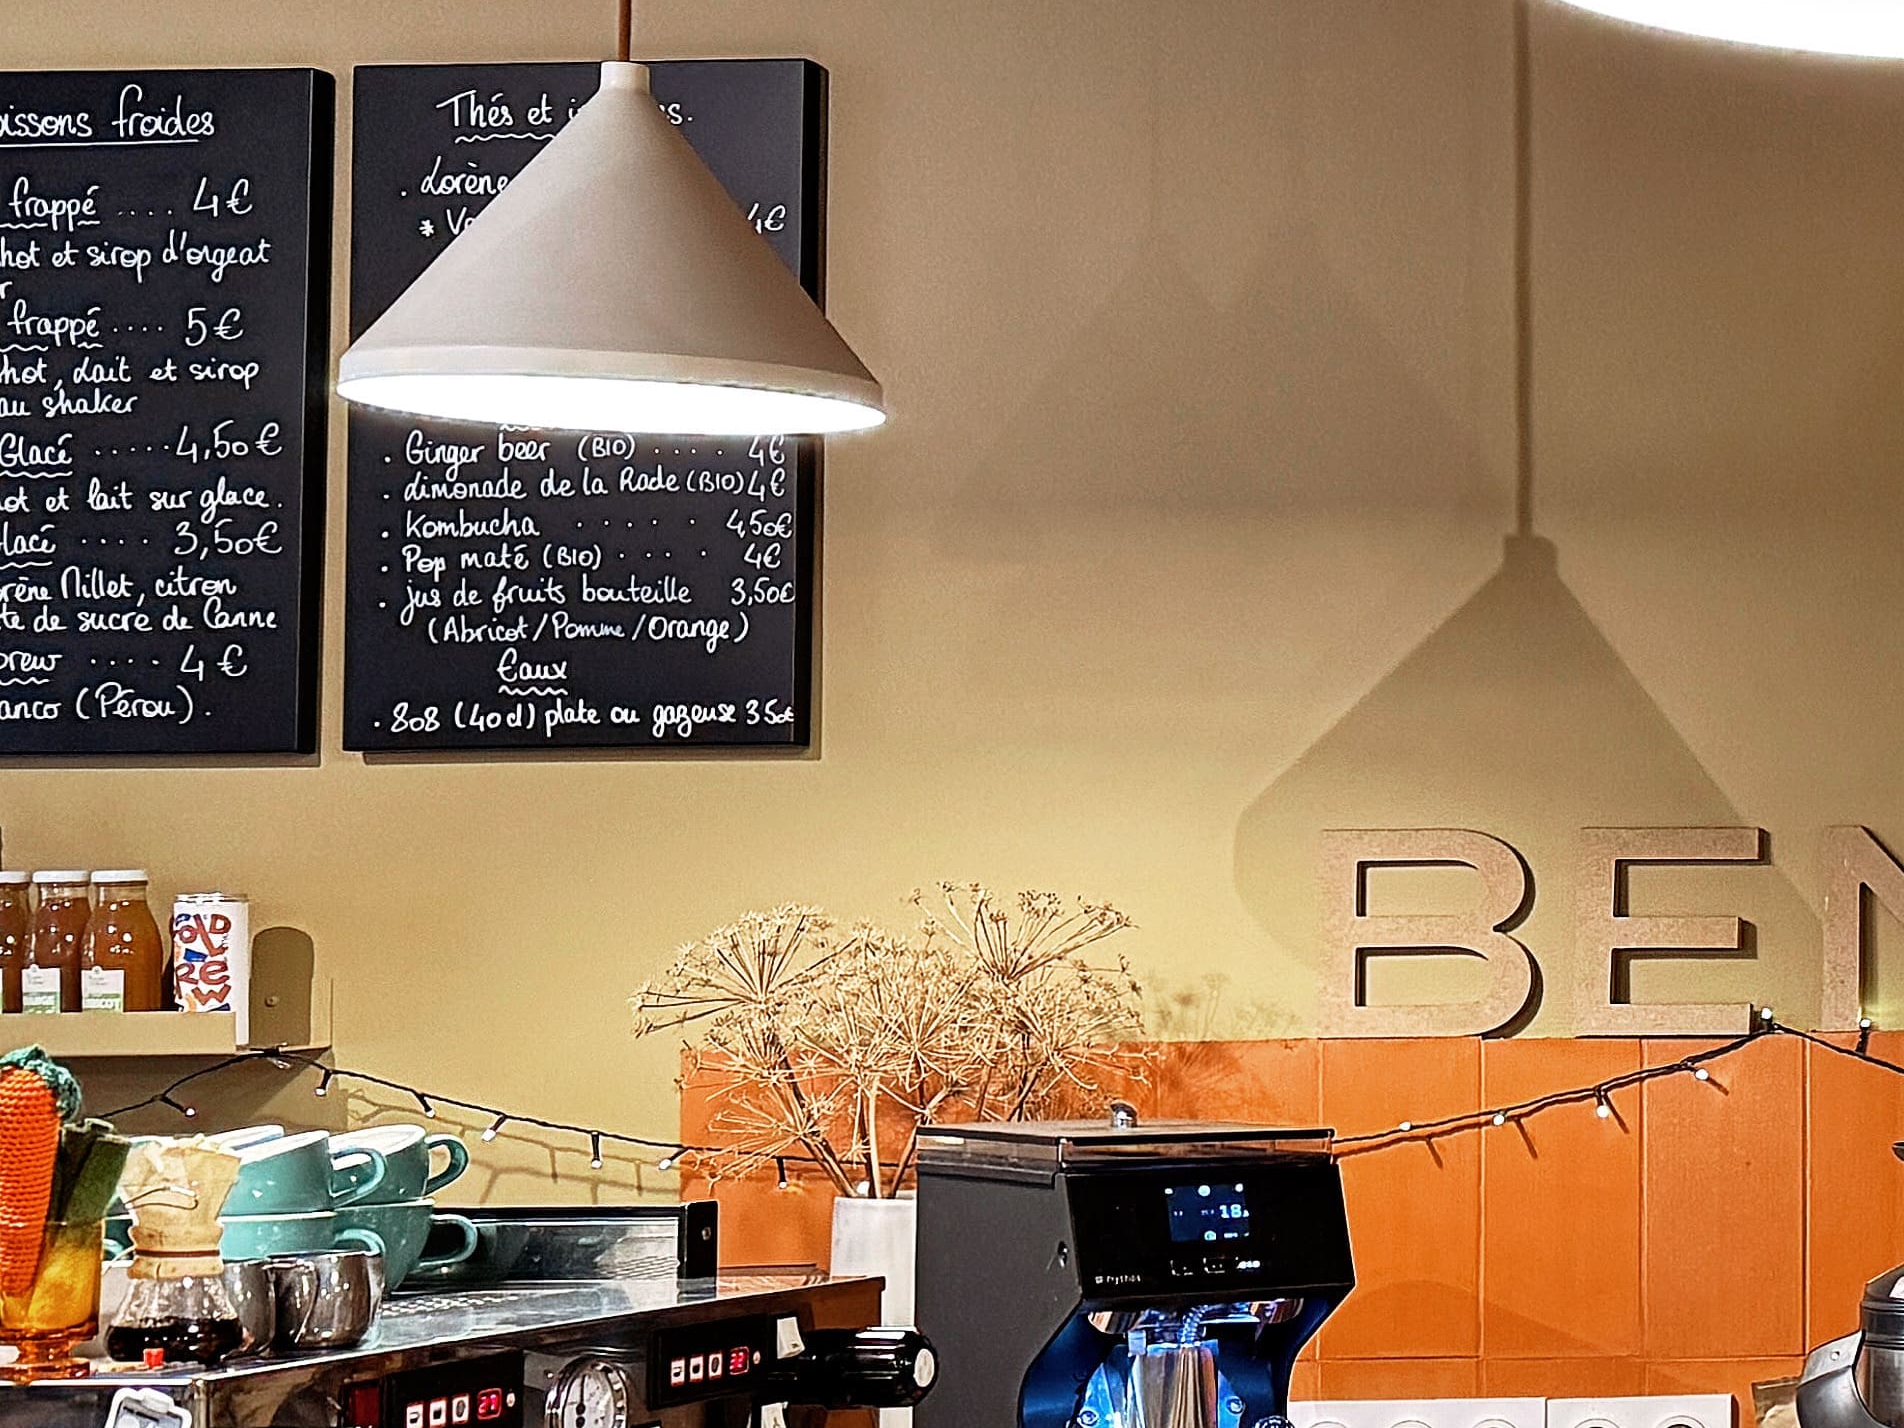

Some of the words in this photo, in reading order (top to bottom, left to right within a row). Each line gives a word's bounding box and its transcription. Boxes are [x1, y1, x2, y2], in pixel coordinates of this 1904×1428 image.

[0, 104, 93, 138] issons
[111, 84, 215, 138] froides
[436, 89, 514, 128] Thés
[528, 93, 552, 126] et
[9, 176, 100, 231] frappé
[193, 177, 253, 218] 4€
[0, 236, 40, 267] hot
[52, 240, 79, 267] et
[86, 241, 151, 283] sirop
[162, 229, 272, 283] d'orgeat
[7, 298, 101, 347] frappé
[184, 307, 244, 347] 5€
[0, 354, 62, 391] hot,
[149, 358, 178, 382] et
[189, 358, 260, 391] sirop
[41, 388, 138, 418] shaker
[0, 432, 73, 468] Glacé
[175, 420, 283, 464] 4,50€
[405, 430, 485, 482] Ginger
[497, 432, 552, 464] beer
[577, 435, 636, 460] (BIO)
[45, 486, 70, 512] et
[86, 477, 134, 511] lait
[149, 488, 193, 511] sur
[540, 471, 576, 498] de
[582, 466, 609, 496] la
[620, 465, 680, 493] Rade
[687, 470, 745, 494] (BIO)
[747, 468, 785, 502] 4€
[0, 521, 56, 556] lacé
[173, 518, 283, 561] 3,50€
[405, 509, 541, 539] Kombucha
[402, 544, 447, 575] Pop
[461, 544, 530, 570] maté
[543, 543, 602, 570] (BIO)
[744, 542, 781, 570] 4€
[0, 576, 53, 603] rène
[155, 565, 237, 599] citron
[400, 579, 442, 628] jus
[453, 577, 483, 607] de
[492, 577, 567, 615] fruits
[582, 575, 692, 606] bouteille
[731, 576, 796, 606] 3,50€
[33, 604, 68, 633] de
[77, 609, 153, 632] sucre
[162, 604, 194, 631] de
[497, 648, 567, 682] Eaux
[0, 699, 62, 721] anco
[545, 697, 600, 738] plate
[610, 706, 641, 724] ou
[652, 703, 737, 738] gazeuse
